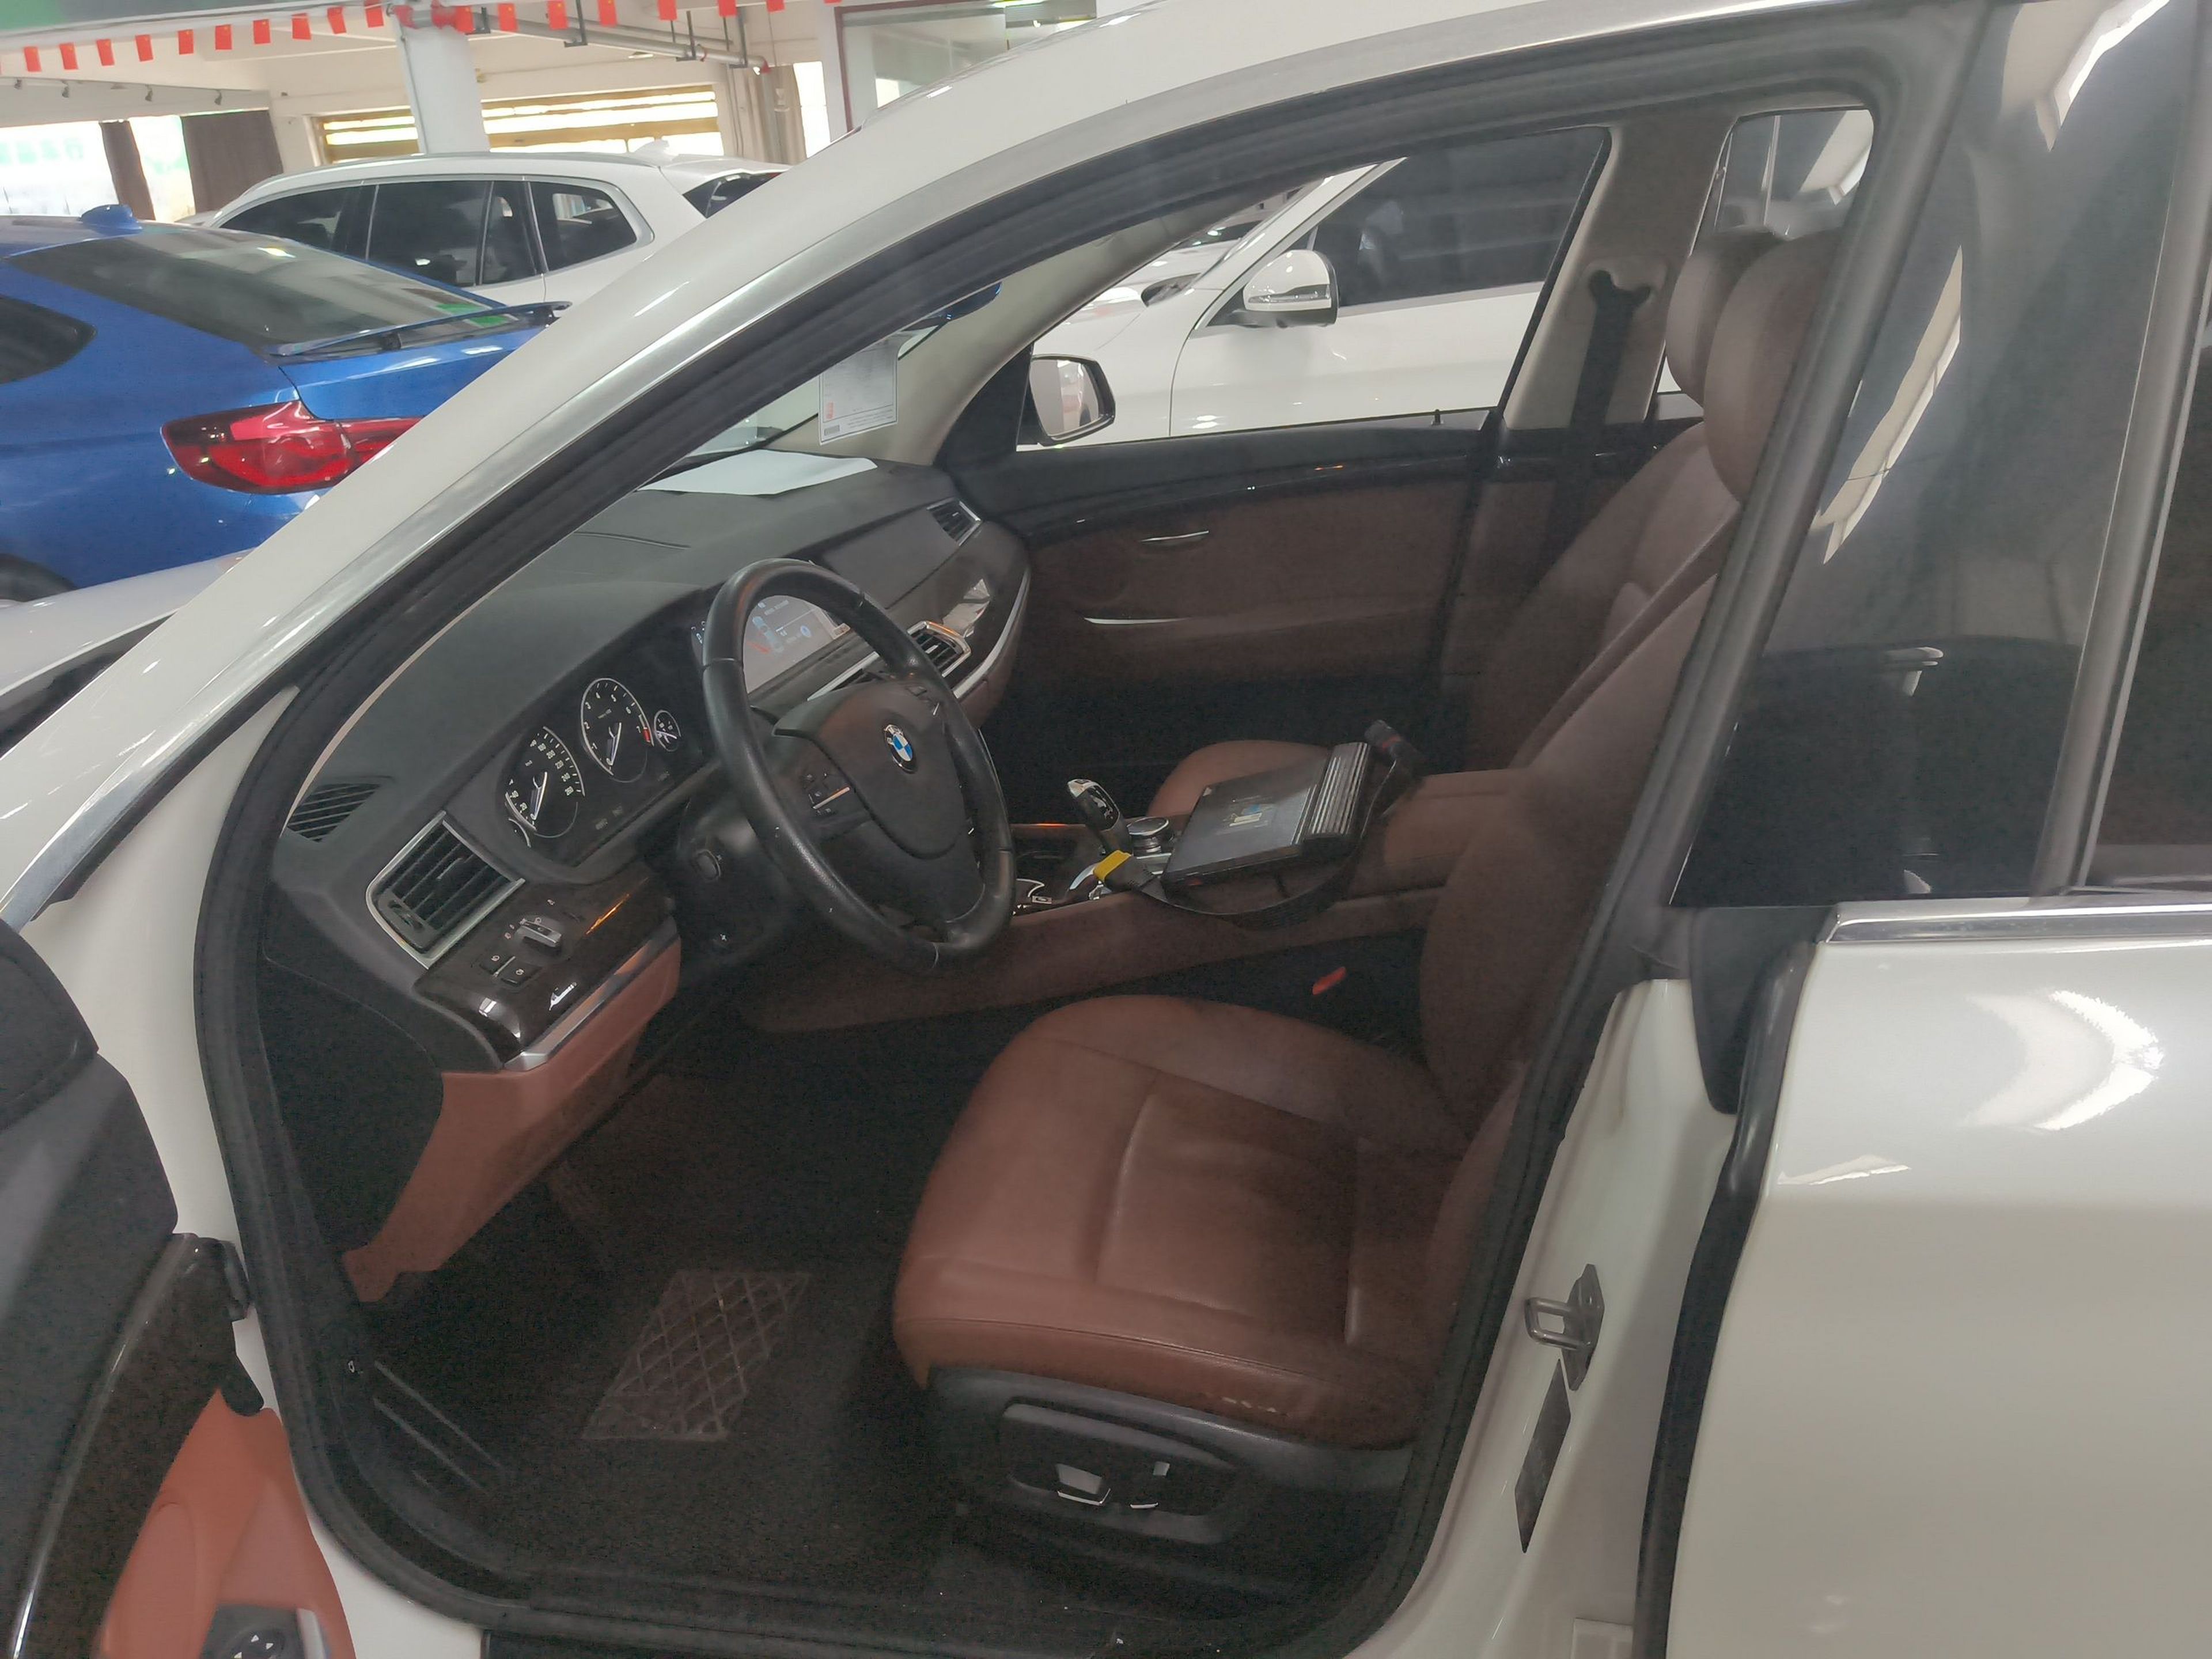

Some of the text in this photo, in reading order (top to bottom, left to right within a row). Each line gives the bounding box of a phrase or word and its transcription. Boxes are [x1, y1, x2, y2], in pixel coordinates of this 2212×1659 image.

[585, 702, 591, 710] 3
[561, 772, 570, 782] 240
[520, 802, 528, 811] 20
